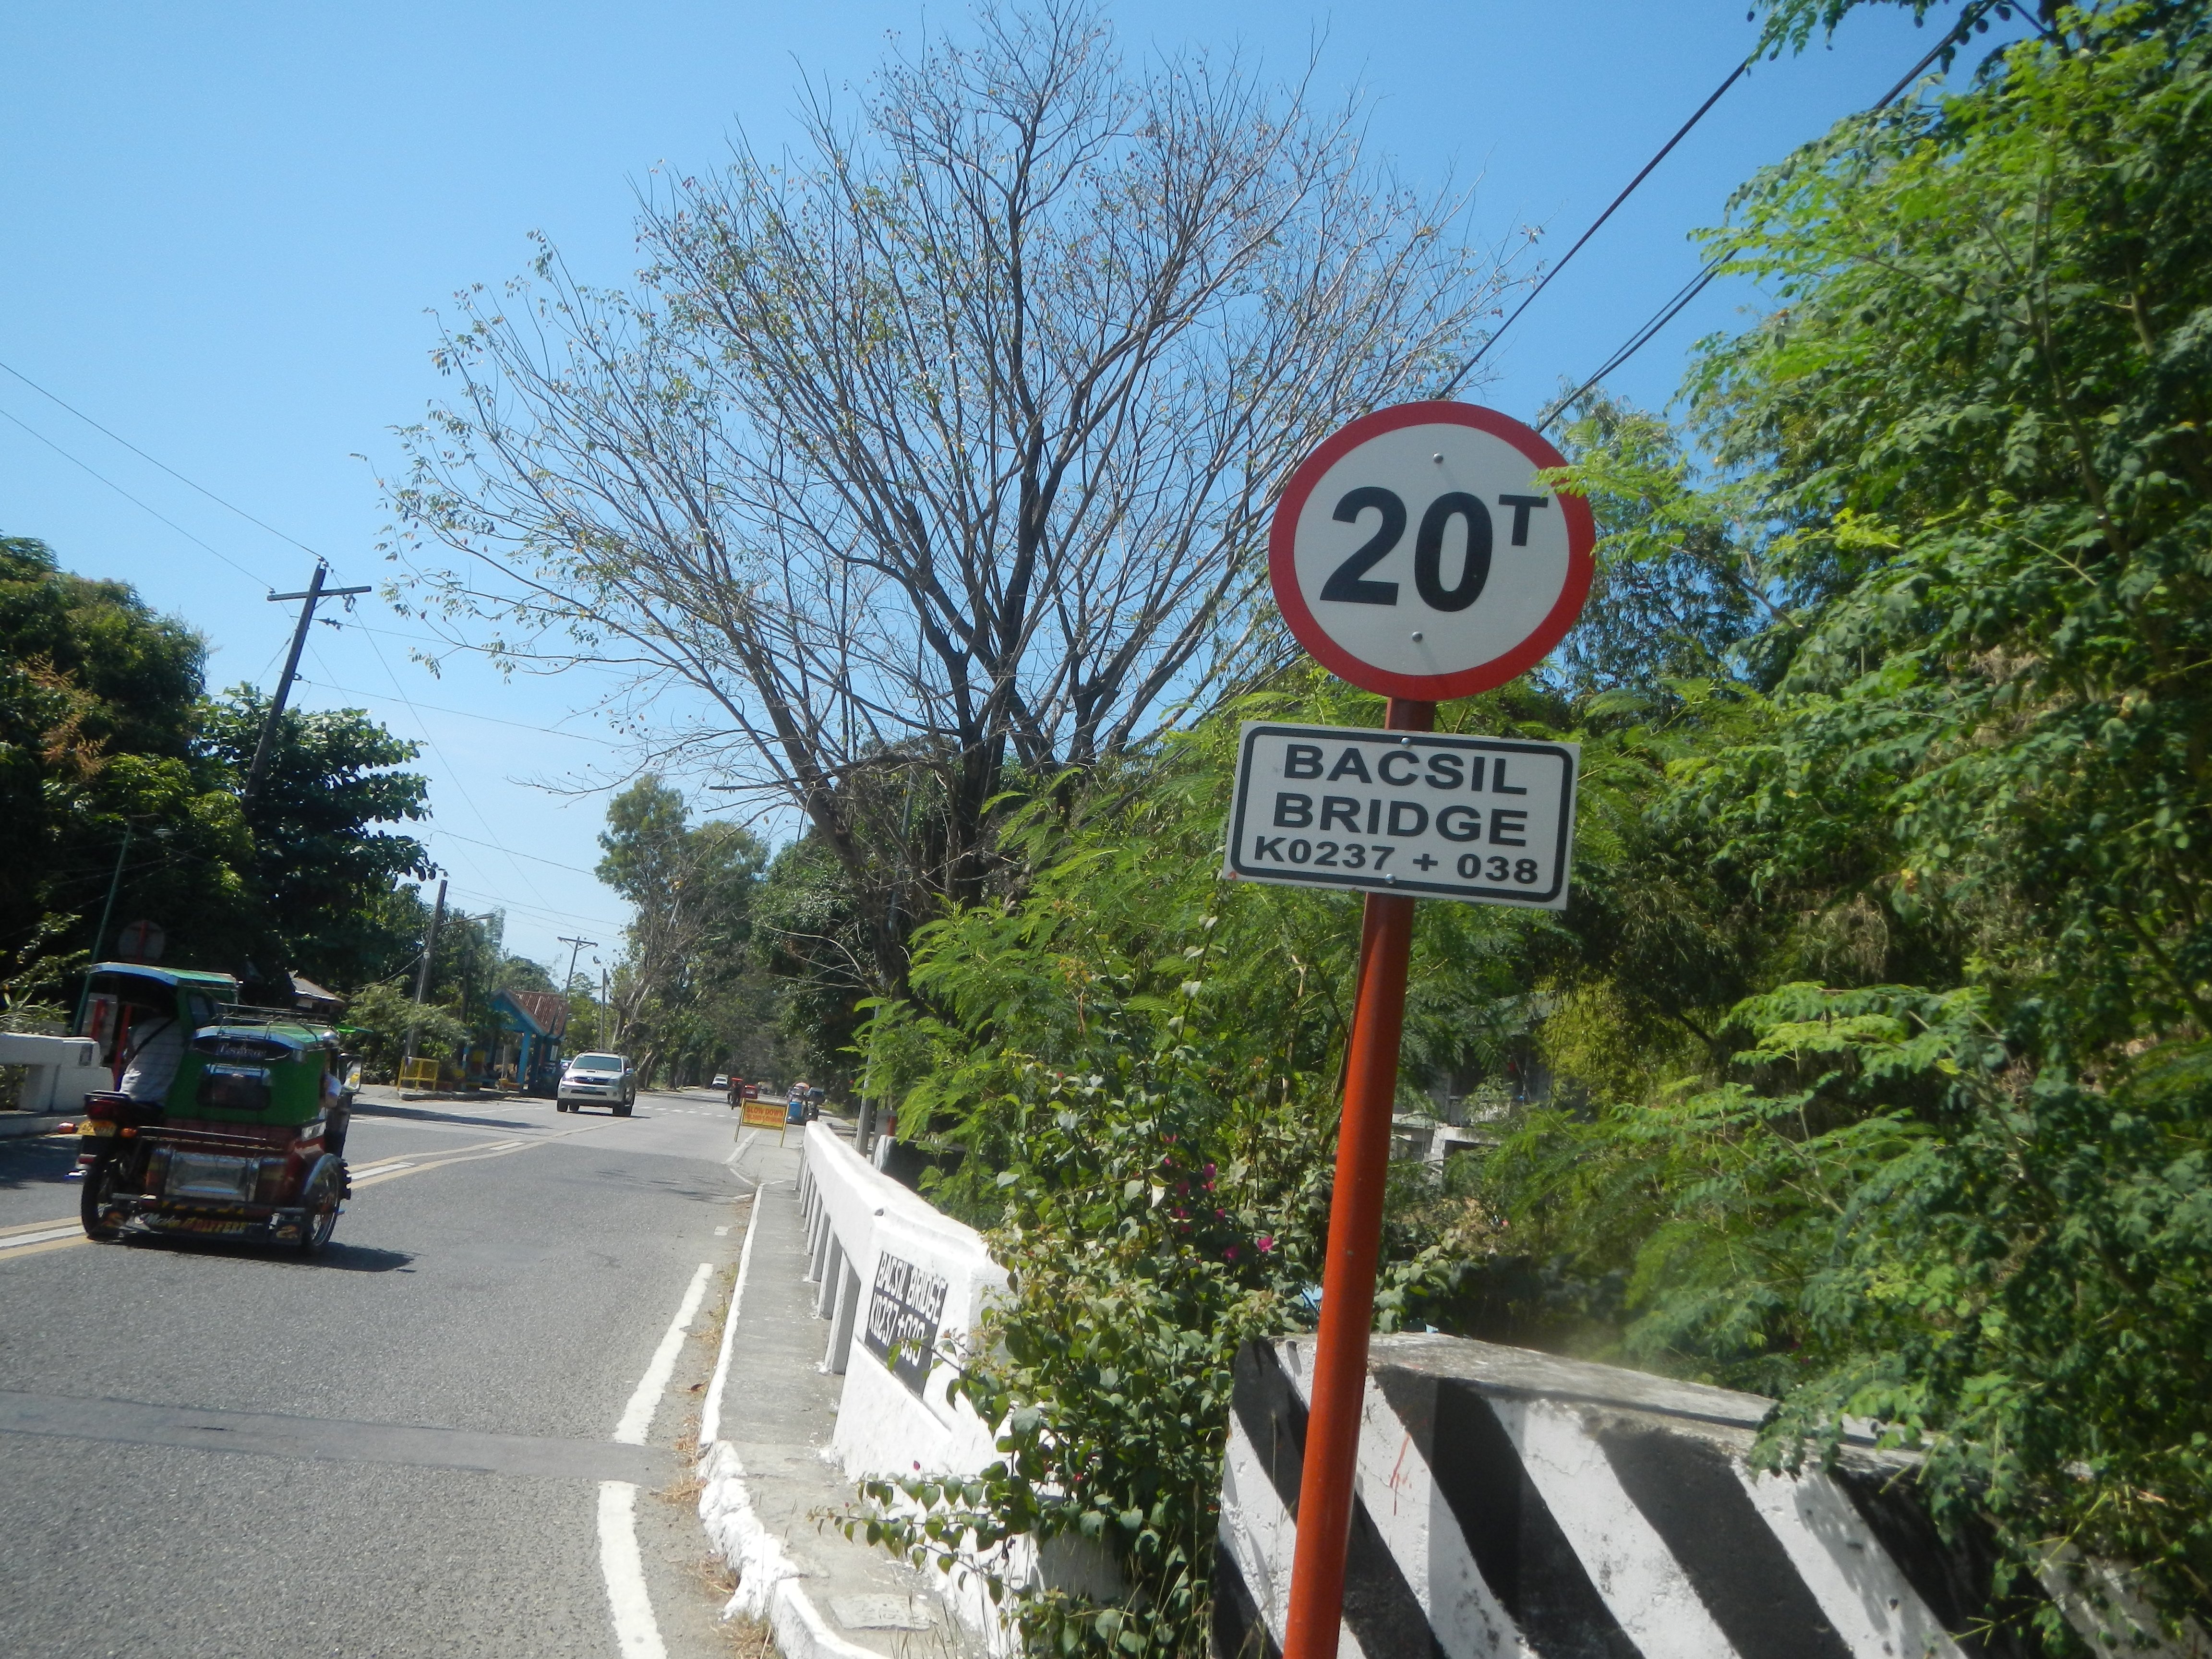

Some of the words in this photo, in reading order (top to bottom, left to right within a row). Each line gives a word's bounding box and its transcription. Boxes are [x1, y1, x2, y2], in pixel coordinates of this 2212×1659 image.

[1284, 744, 1527, 795] BACSIL
[1273, 792, 1527, 847] BRIDGE
[1254, 836, 1395, 870] K0237
[1457, 854, 1538, 884] 038
[746, 1106, 763, 1114] SLOW
[876, 1251, 908, 1301] BACSIL
[905, 1265, 947, 1325] BRIDGE
[869, 1292, 900, 1346] K0237
